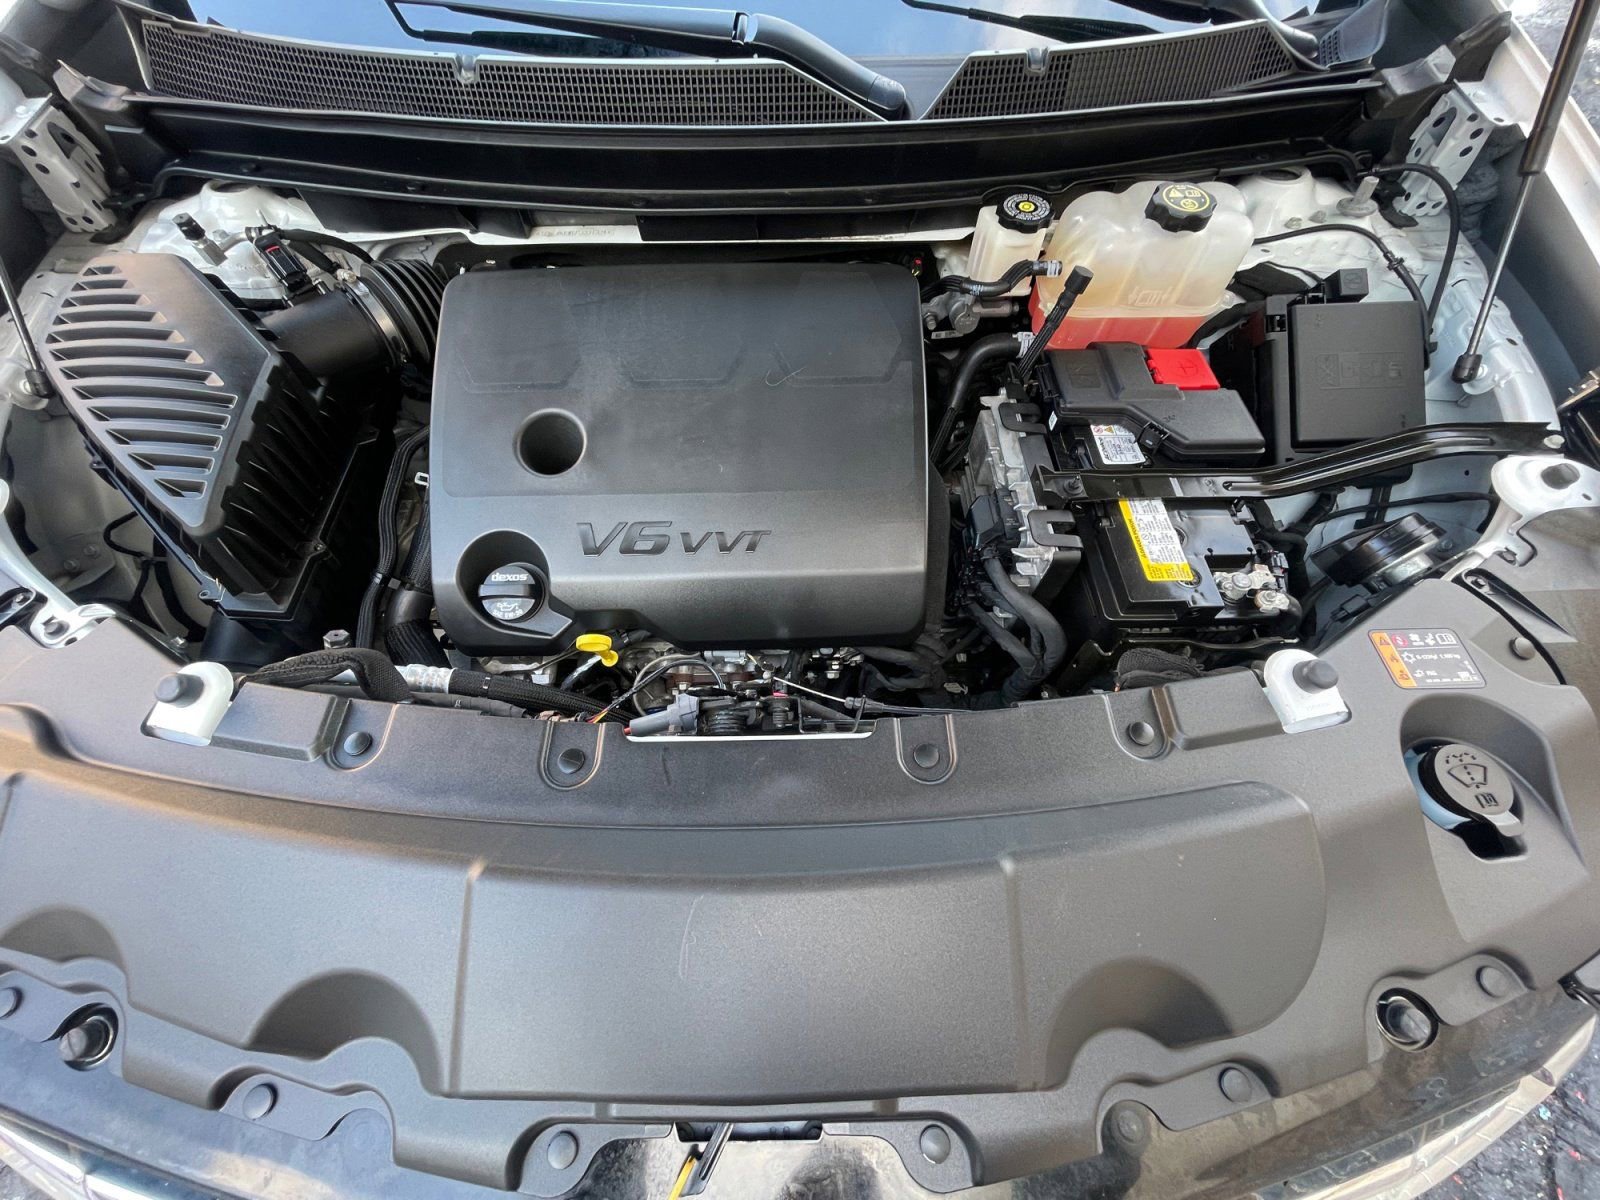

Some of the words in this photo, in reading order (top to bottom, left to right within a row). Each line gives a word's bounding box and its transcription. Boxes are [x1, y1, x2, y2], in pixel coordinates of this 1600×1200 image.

[576, 521, 673, 556] V6
[680, 530, 772, 554] VVT
[491, 572, 529, 582] dexos
